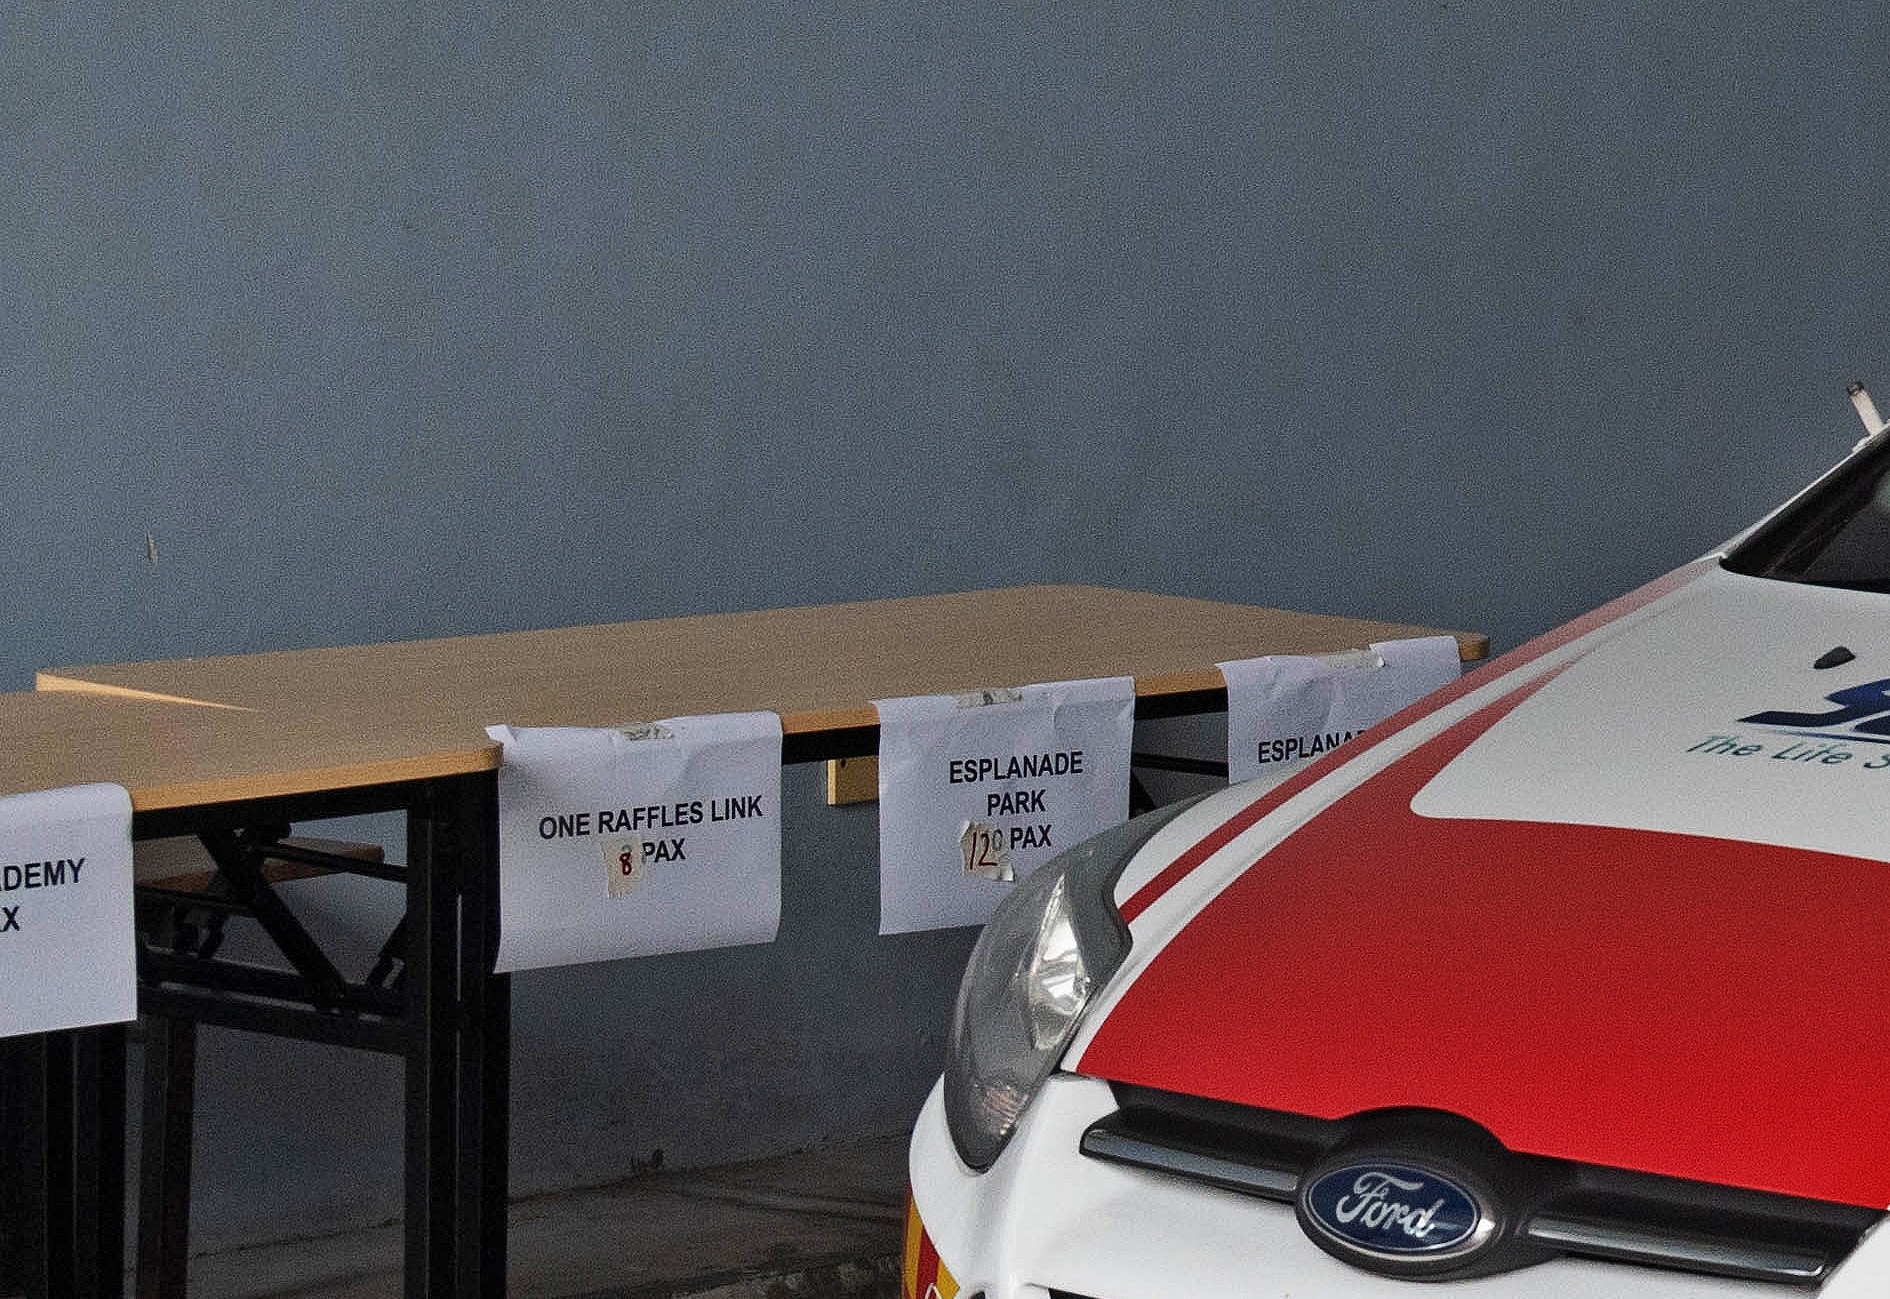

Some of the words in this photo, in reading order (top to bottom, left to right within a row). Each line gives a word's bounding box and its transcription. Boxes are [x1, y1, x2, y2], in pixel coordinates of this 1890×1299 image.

[1685, 734, 1763, 757] The
[1771, 742, 1854, 765] Life
[949, 750, 1084, 785] ESPLANADE
[538, 813, 591, 840] ONE
[597, 801, 705, 834] RAFFLES
[711, 794, 764, 823] LINK
[987, 788, 1047, 818] PARK
[640, 837, 687, 866] PAX
[1009, 823, 1053, 851] PAX
[1333, 1168, 1446, 1239] Ford
